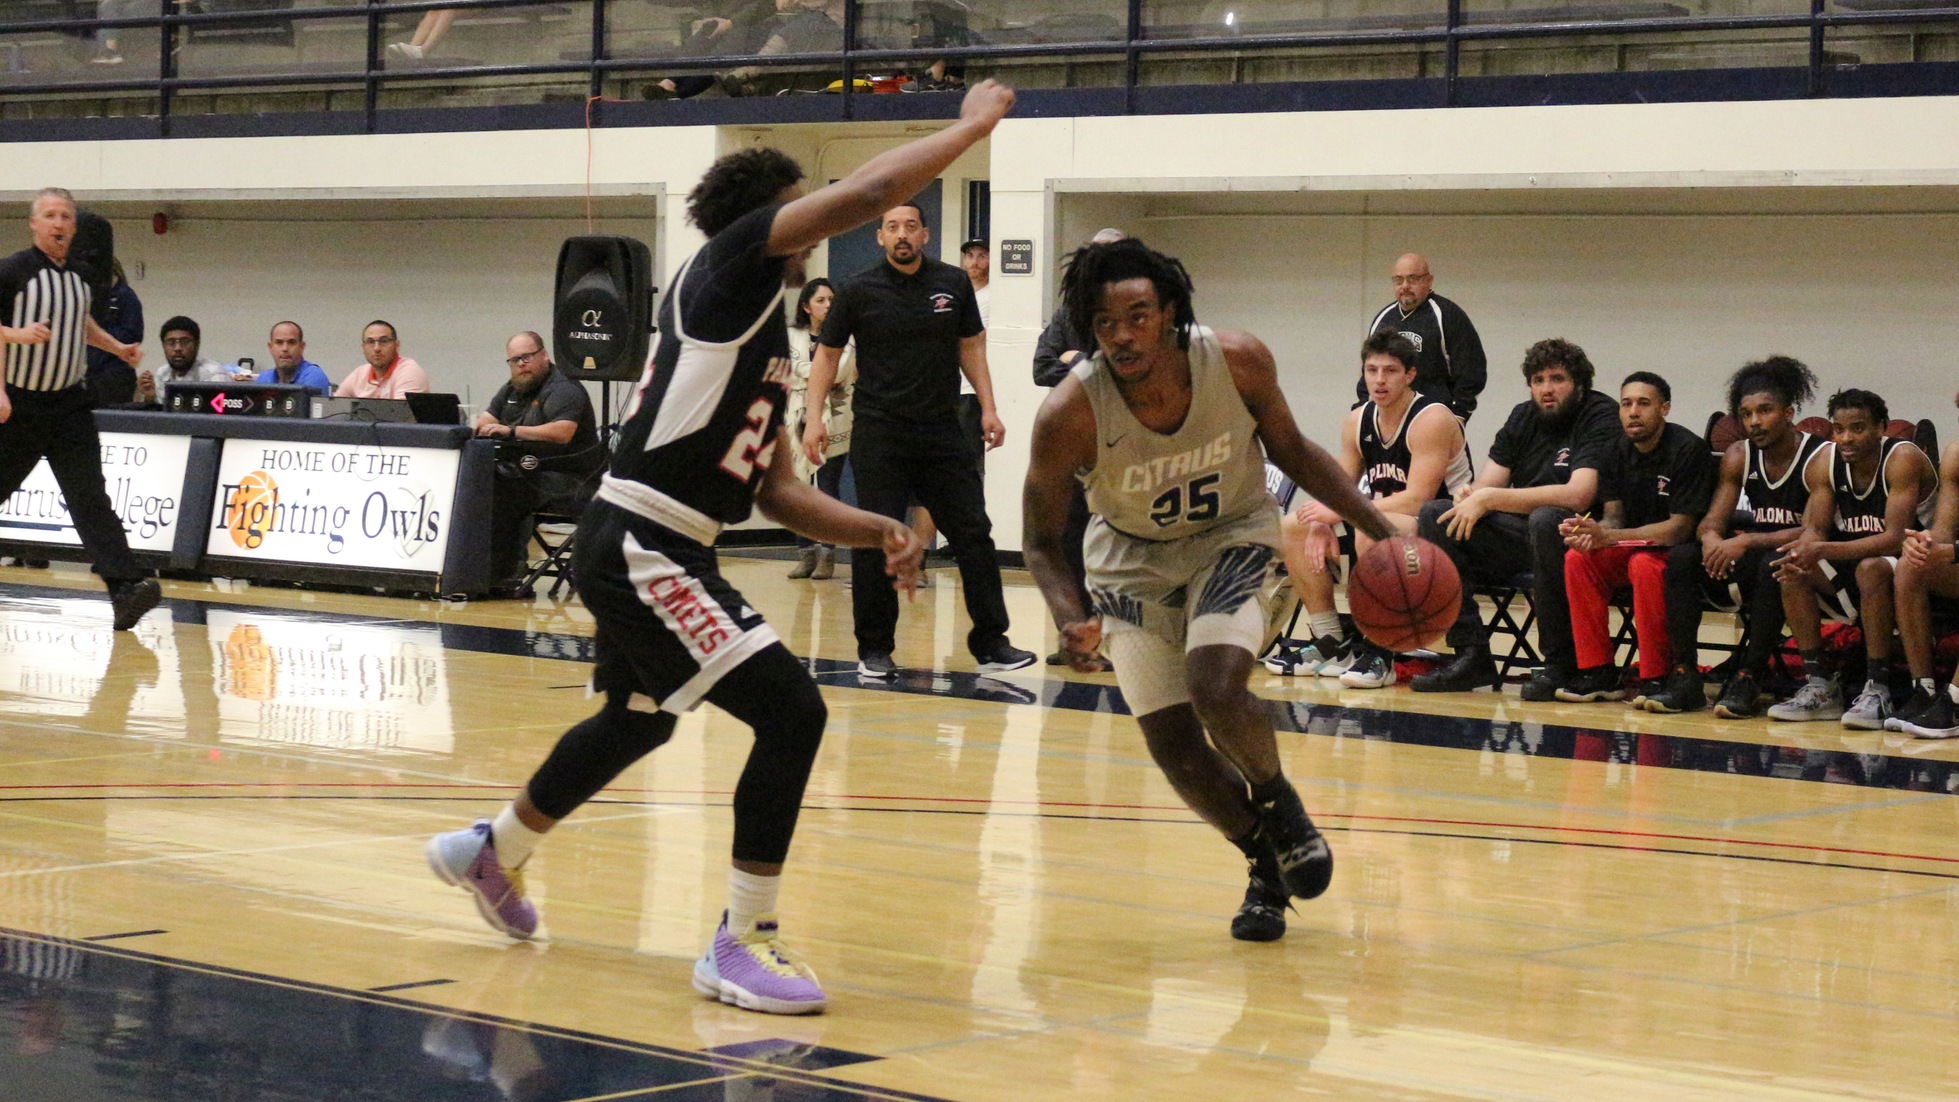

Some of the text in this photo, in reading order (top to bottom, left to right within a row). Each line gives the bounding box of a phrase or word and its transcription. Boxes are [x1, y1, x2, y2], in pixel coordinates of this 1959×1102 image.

[1005, 262, 1028, 270] DRINKS
[1012, 253, 1022, 261] OR
[222, 398, 243, 409] POSS
[123, 446, 148, 467] TO
[261, 449, 411, 476] HOME OF THE
[1122, 432, 1231, 493] CITRUS
[1150, 470, 1222, 528] 25
[215, 483, 440, 555] Fighting Owls
